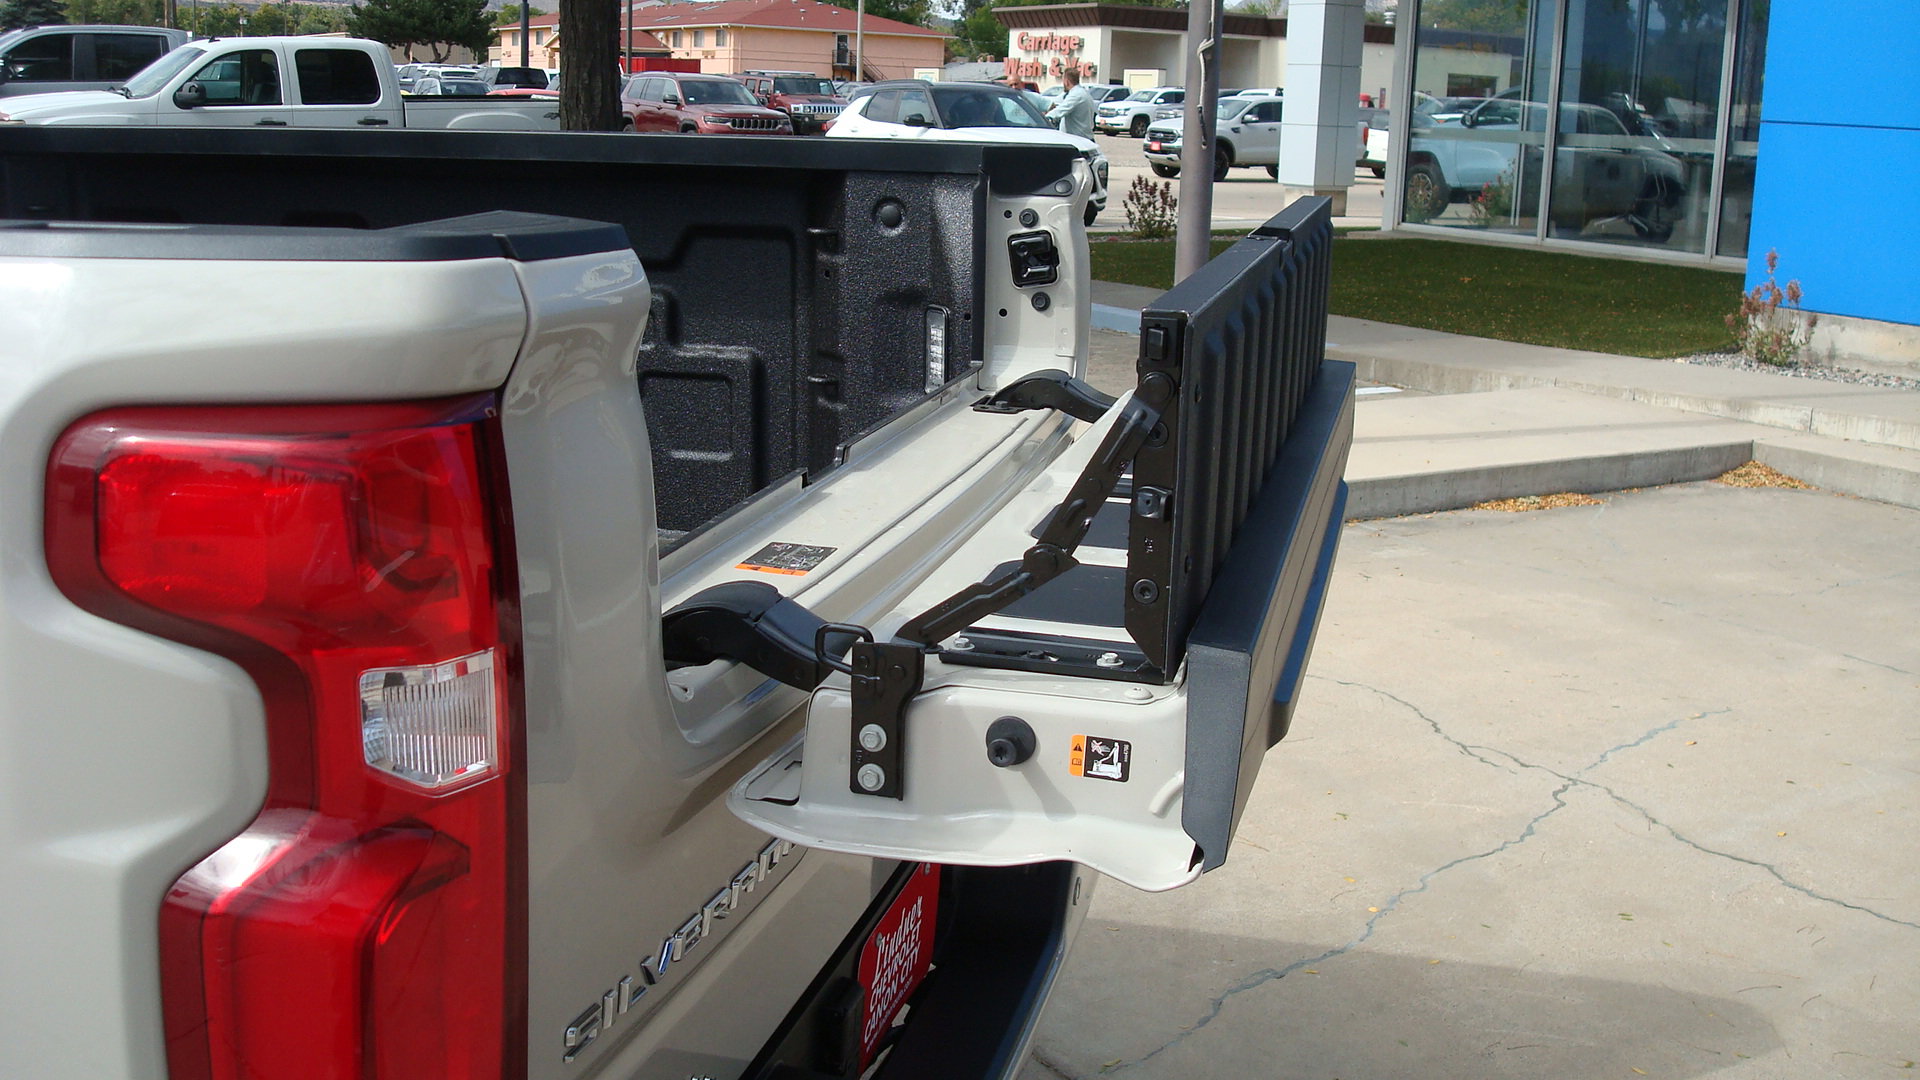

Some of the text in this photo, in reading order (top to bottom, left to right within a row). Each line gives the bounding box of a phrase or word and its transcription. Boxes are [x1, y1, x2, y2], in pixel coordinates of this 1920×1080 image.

[1003, 57, 1042, 77] Wash
[1049, 57, 1062, 77] &
[1017, 32, 1080, 55] Carriage
[563, 836, 798, 1064] SILVERAD
[870, 919, 922, 1013] CHEVROLET
[872, 895, 923, 990] Lindner
[864, 978, 899, 1044] CANON
[900, 941, 922, 984] CITY
